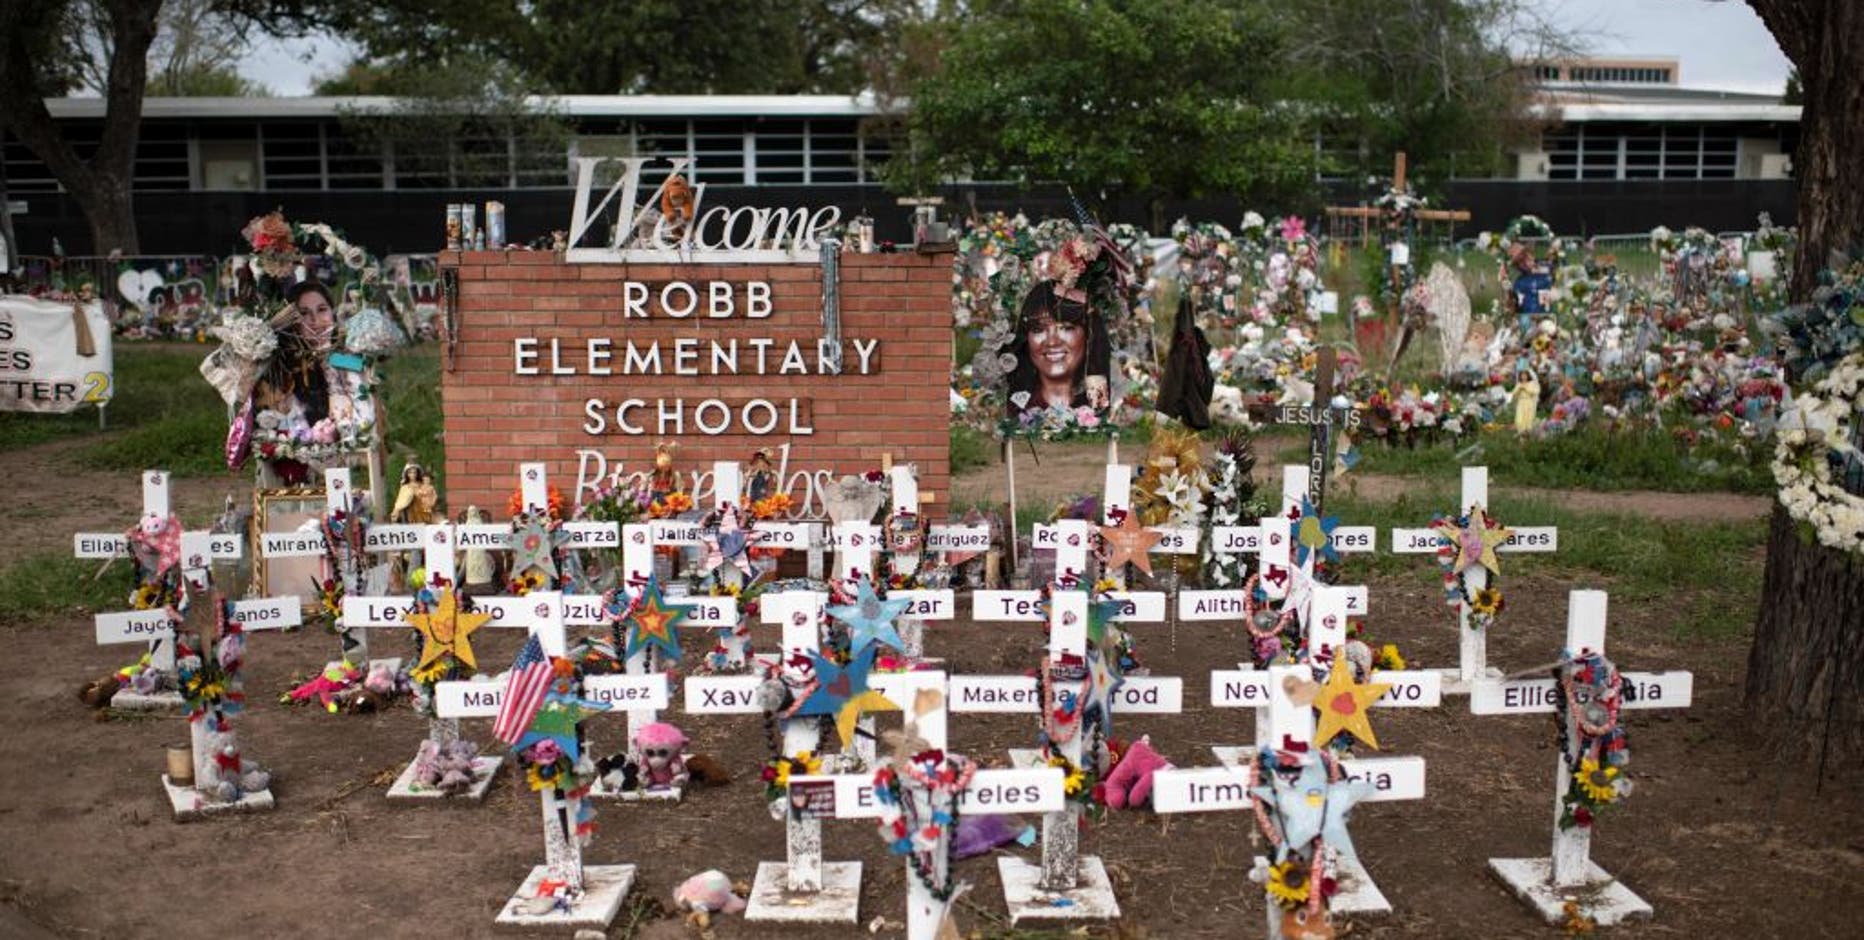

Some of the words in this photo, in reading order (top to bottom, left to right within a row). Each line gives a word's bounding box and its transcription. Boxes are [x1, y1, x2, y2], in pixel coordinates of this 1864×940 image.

[568, 156, 841, 251] Welcome
[624, 281, 773, 318] ROBB
[515, 338, 878, 375] ELEMENTARY
[84, 372, 109, 402] 2
[584, 397, 813, 435] SCHOOL
[1275, 407, 1333, 425] JESUS
[1344, 409, 1361, 427] IS
[368, 531, 417, 546] athis
[460, 532, 500, 545] Ame
[573, 530, 616, 542] arza
[762, 531, 794, 542] ero
[910, 534, 988, 547] Rdriguez
[1161, 535, 1184, 547] es
[1224, 533, 1257, 548] Jos
[1408, 537, 1437, 548] Jac
[1506, 533, 1550, 546] ares
[211, 540, 235, 553] es
[235, 606, 281, 622] anos
[369, 604, 416, 622] Lex
[563, 604, 603, 622] Uziy
[688, 604, 720, 617] cia
[903, 600, 942, 615] zar
[1001, 598, 1043, 615] Tes
[463, 689, 500, 707] Mai
[585, 686, 650, 702] iguez
[702, 687, 753, 707] Xav
[1111, 686, 1158, 704] rod
[1225, 682, 1270, 700] Nev
[1386, 683, 1421, 700] vo
[961, 785, 1041, 805] reles
[1189, 782, 1251, 803] Irm
